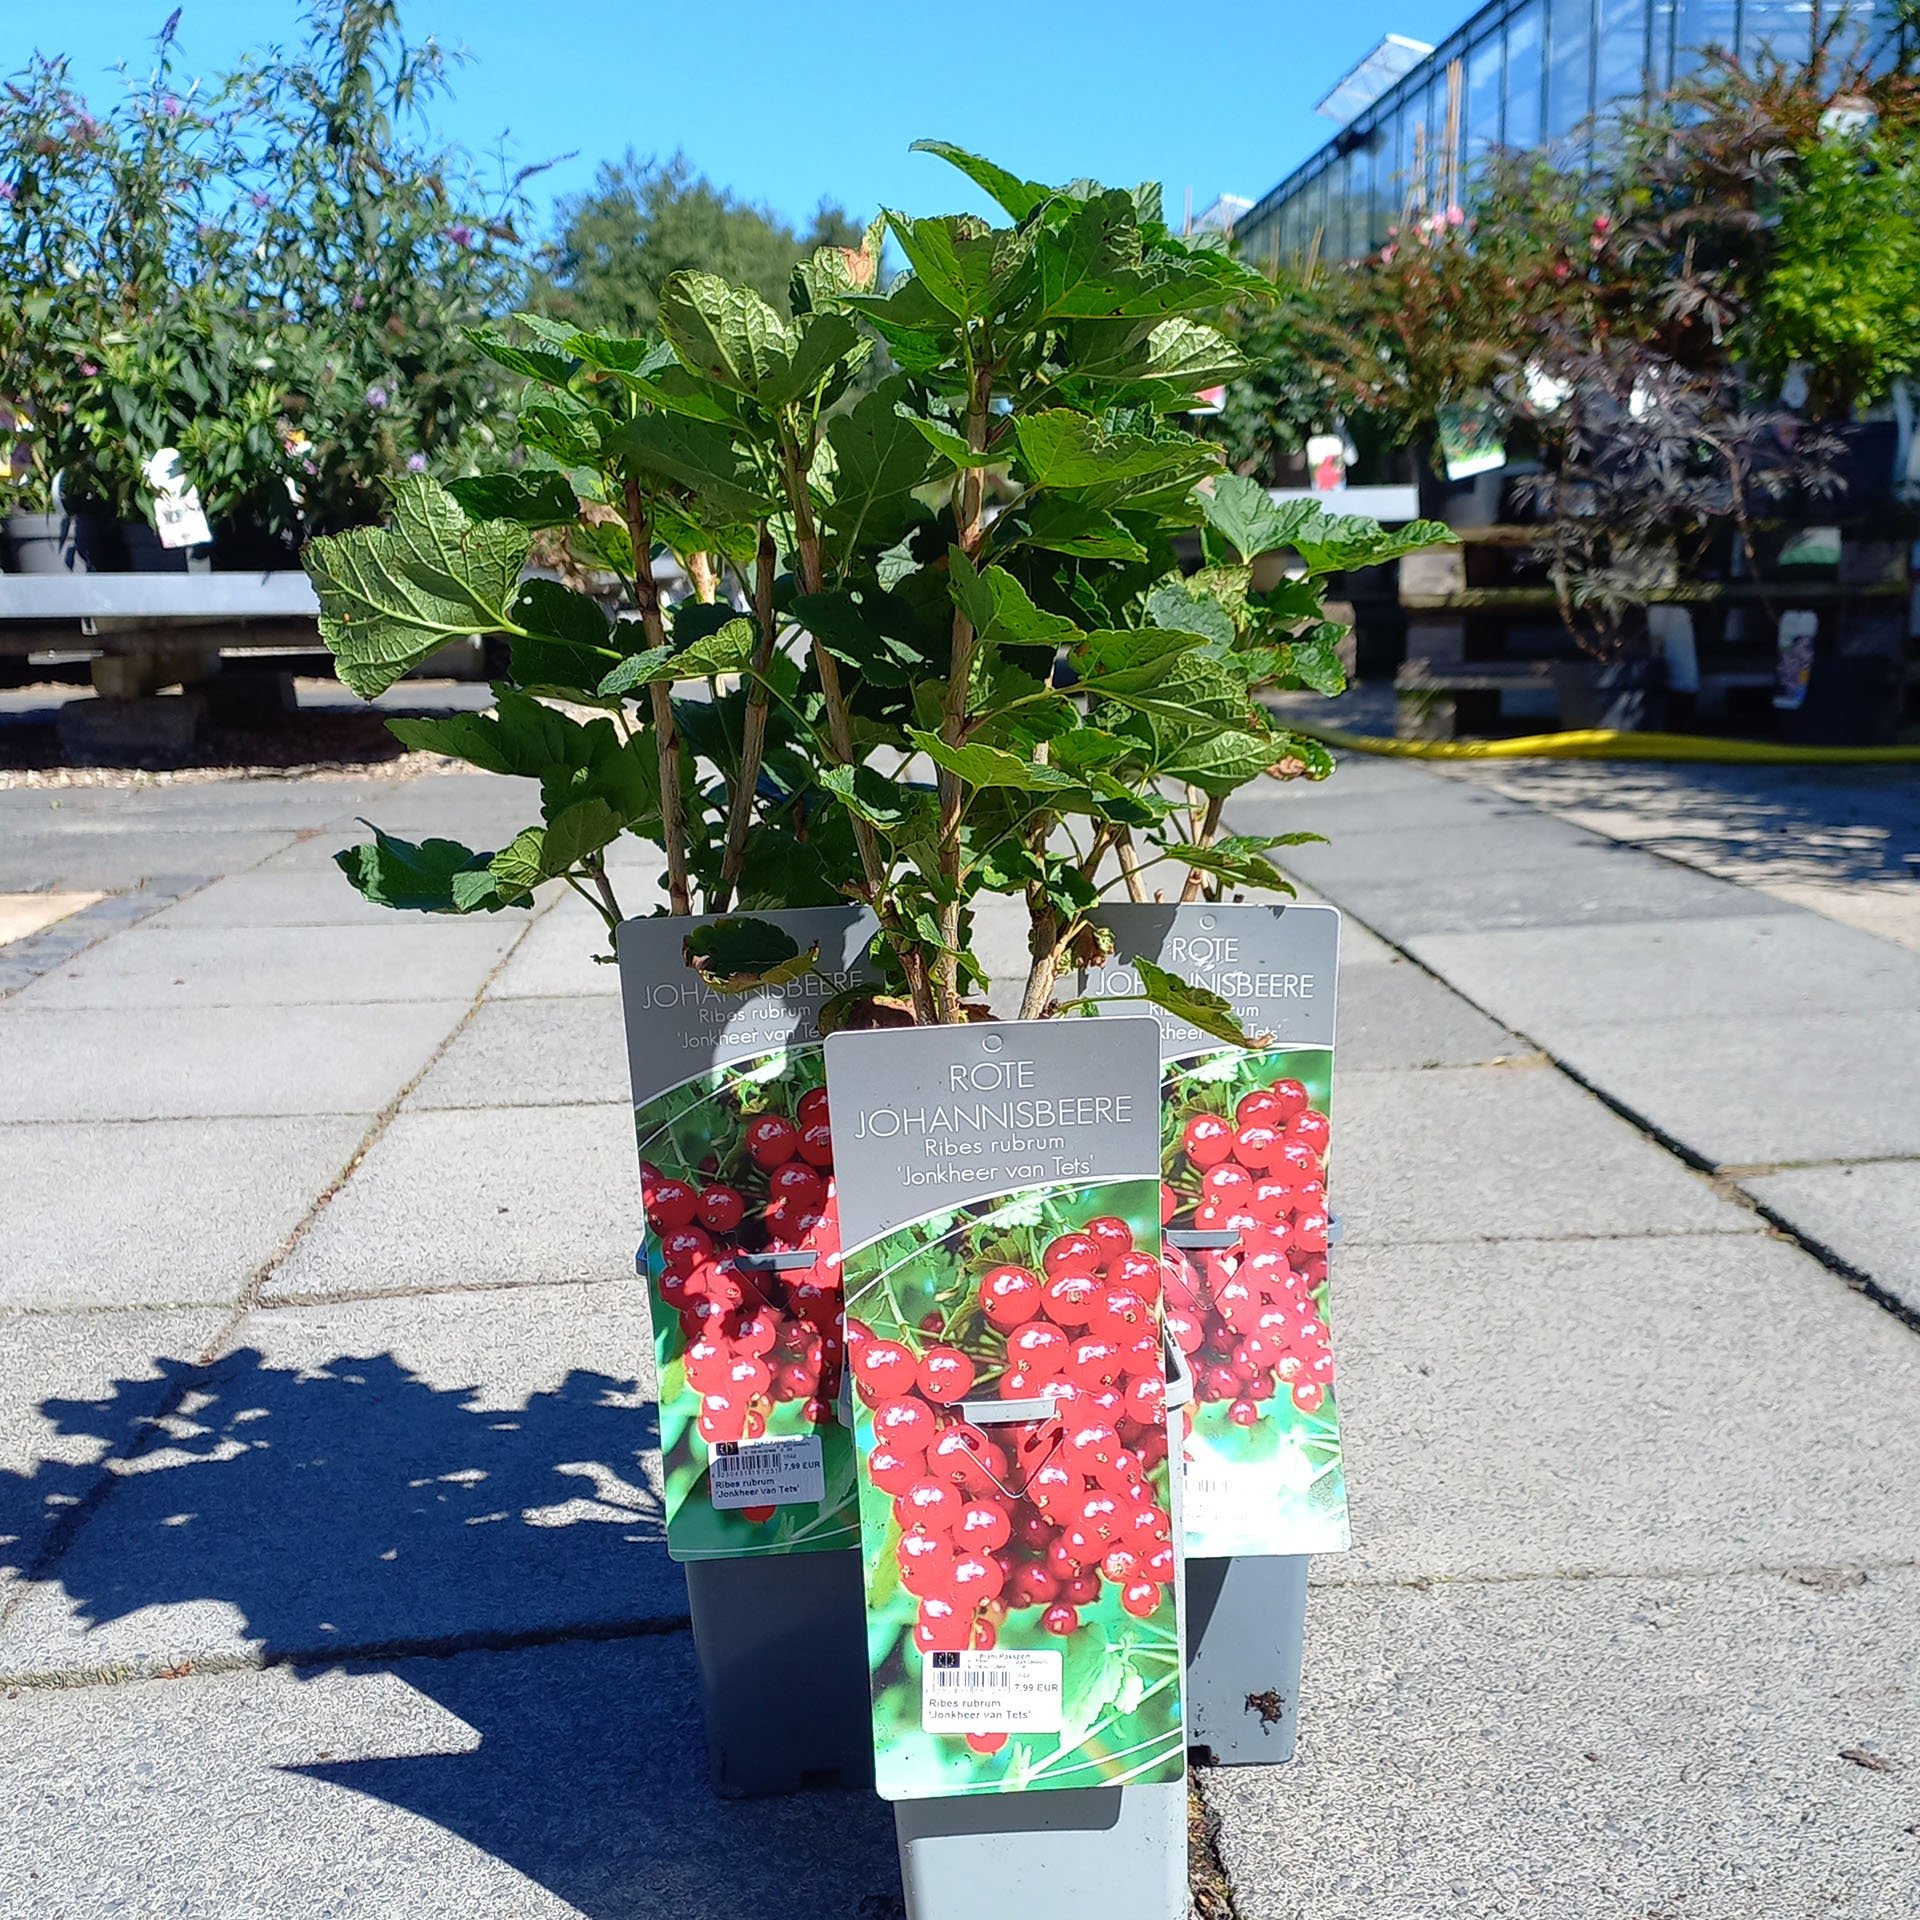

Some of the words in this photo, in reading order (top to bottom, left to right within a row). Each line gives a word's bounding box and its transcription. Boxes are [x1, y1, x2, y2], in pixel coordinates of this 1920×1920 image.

[1172, 937, 1239, 962] ROTE
[700, 1007, 746, 1023] Ribes
[752, 1002, 811, 1020] rubrum
[677, 1029, 759, 1049] 'Jonkheer
[764, 1029, 795, 1042] van
[949, 1060, 1035, 1093] ROTE
[854, 1096, 1133, 1140] JOHANNISBEERE
[925, 1137, 983, 1158] Ribes
[991, 1132, 1065, 1154] rubrum
[897, 1161, 998, 1187] 'Jonkheer
[1005, 1163, 1044, 1180] van
[1052, 1153, 1095, 1176] Tets'
[783, 1462, 801, 1471] 7,99
[802, 1461, 821, 1470] EUR
[715, 1481, 740, 1489] Ribes
[743, 1479, 775, 1487] rubrum
[1037, 1683, 1059, 1692] EUR
[929, 1699, 959, 1708] Ribes
[962, 1698, 1001, 1708] rubrum
[929, 1710, 980, 1719] 'Jonkheer
